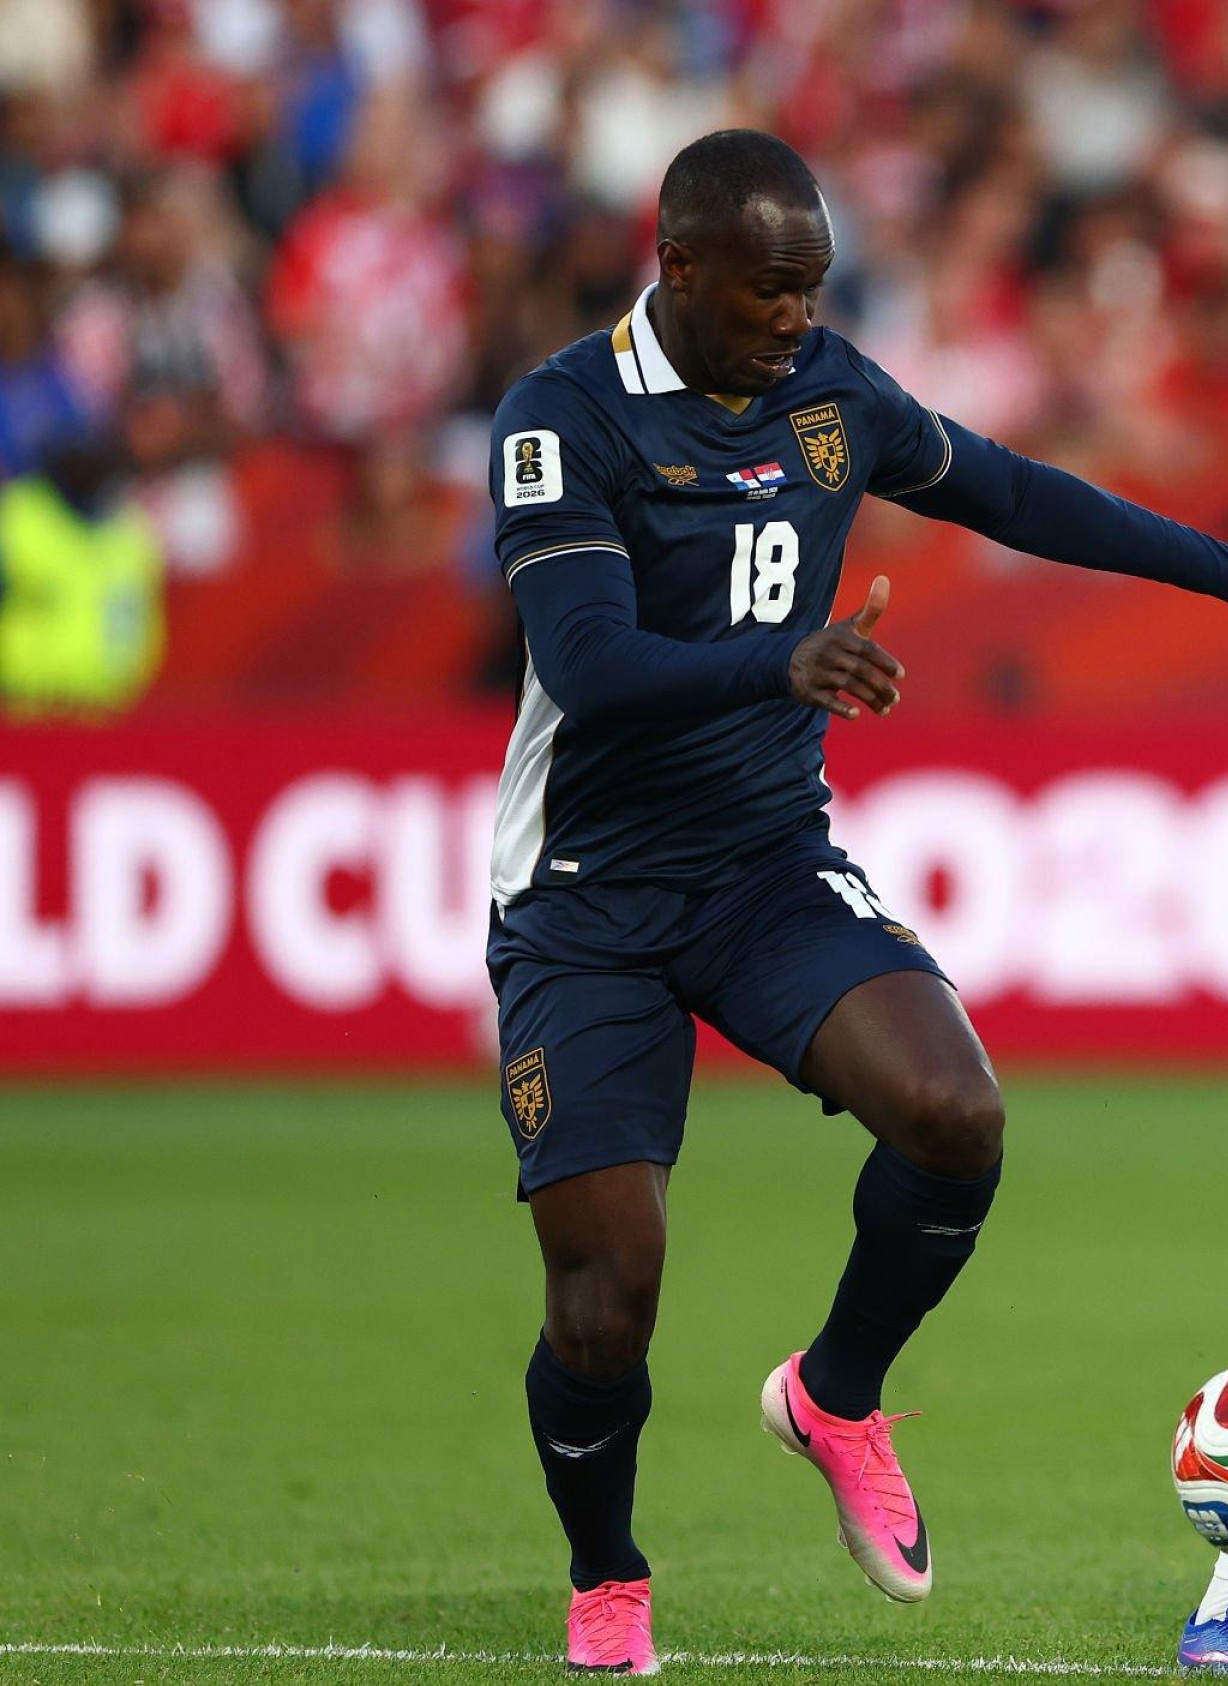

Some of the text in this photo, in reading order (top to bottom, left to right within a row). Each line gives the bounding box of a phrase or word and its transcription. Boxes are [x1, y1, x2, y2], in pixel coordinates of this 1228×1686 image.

[516, 489, 546, 499] 2026
[730, 520, 800, 626] 18
[243, 768, 496, 1009] CU
